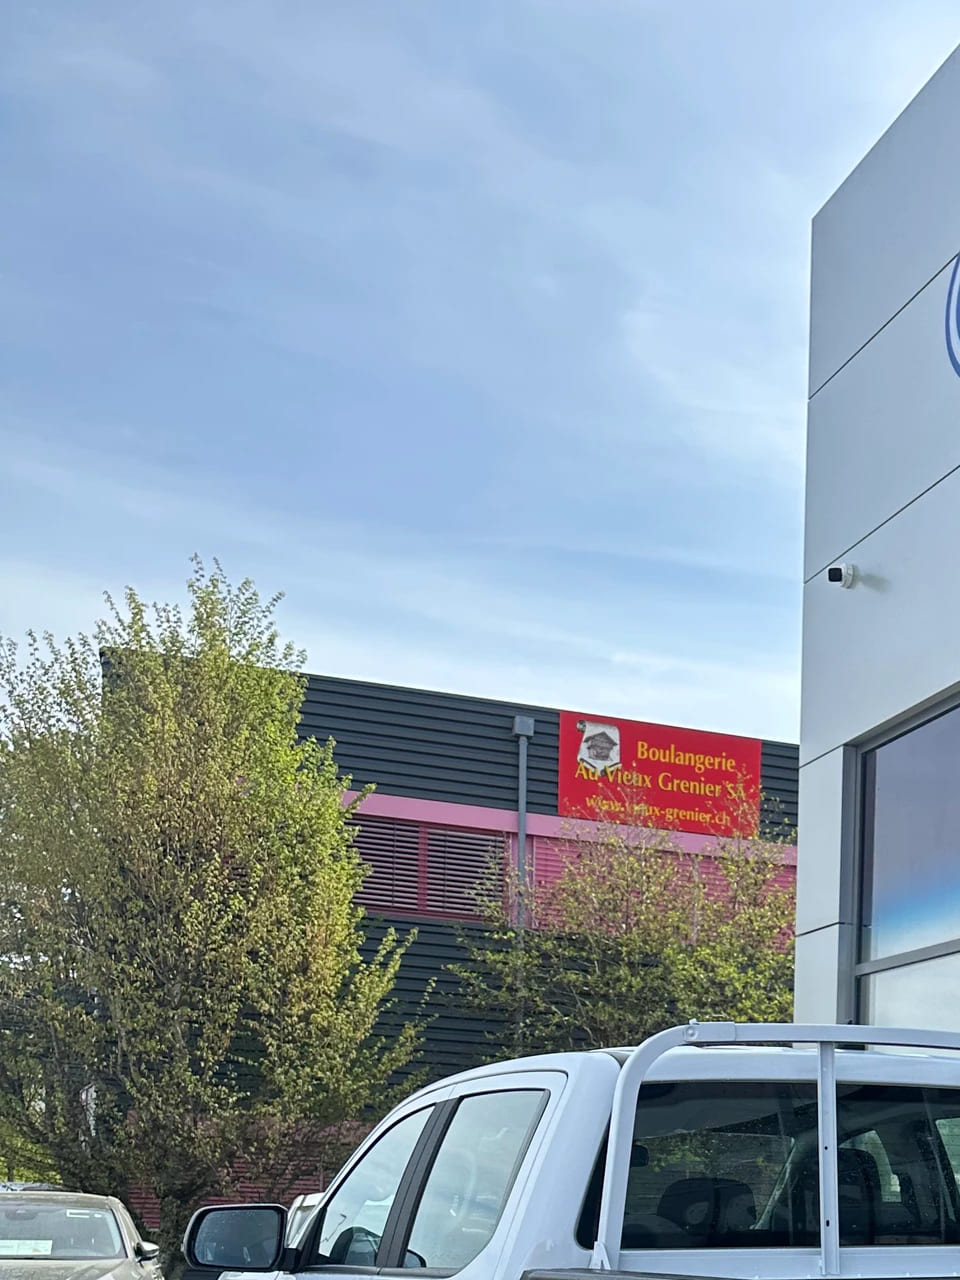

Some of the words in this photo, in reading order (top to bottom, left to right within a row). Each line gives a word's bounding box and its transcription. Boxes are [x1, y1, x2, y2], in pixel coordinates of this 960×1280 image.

[637, 741, 736, 773] Boulangerie
[574, 760, 599, 781] Au
[604, 764, 652, 788] Vieux
[658, 772, 722, 797] Grenier
[726, 782, 746, 801] SA
